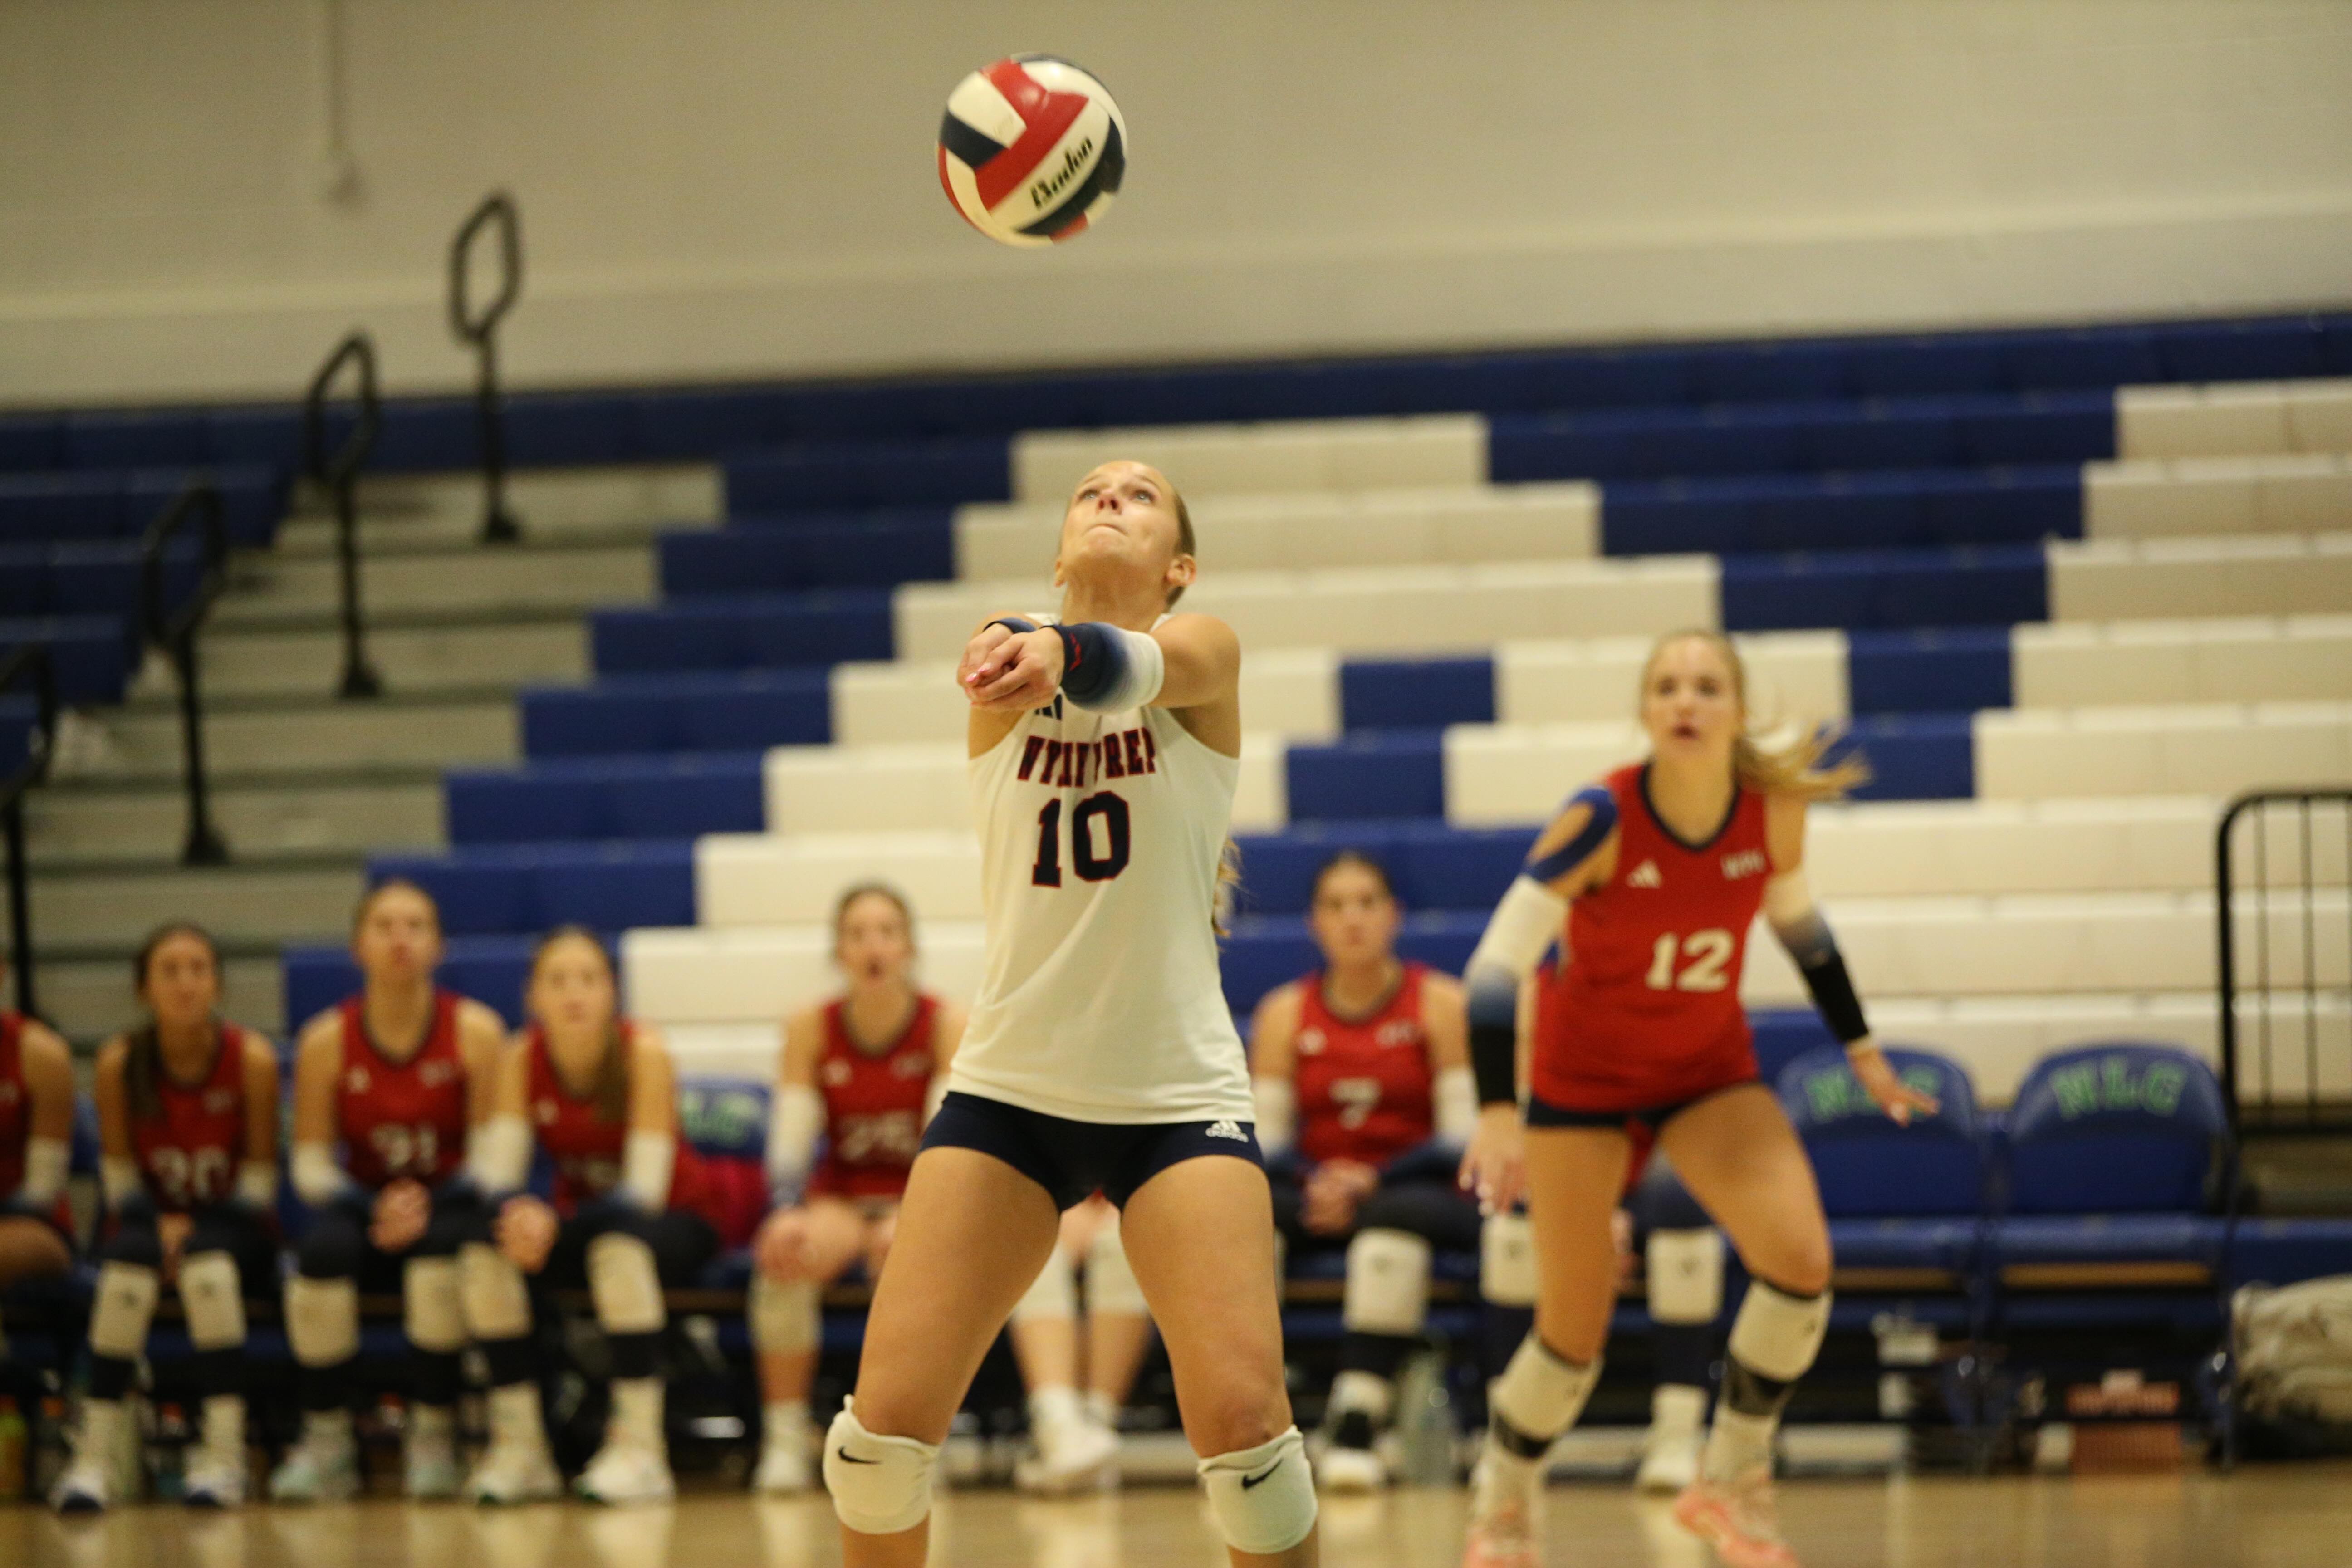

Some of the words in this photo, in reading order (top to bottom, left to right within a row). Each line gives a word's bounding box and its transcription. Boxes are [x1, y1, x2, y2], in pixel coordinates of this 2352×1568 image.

[1031, 791, 1131, 888] 10
[1644, 927, 1735, 993] 12
[1328, 1077, 1382, 1131] 7
[2051, 1057, 2188, 1120] NLC
